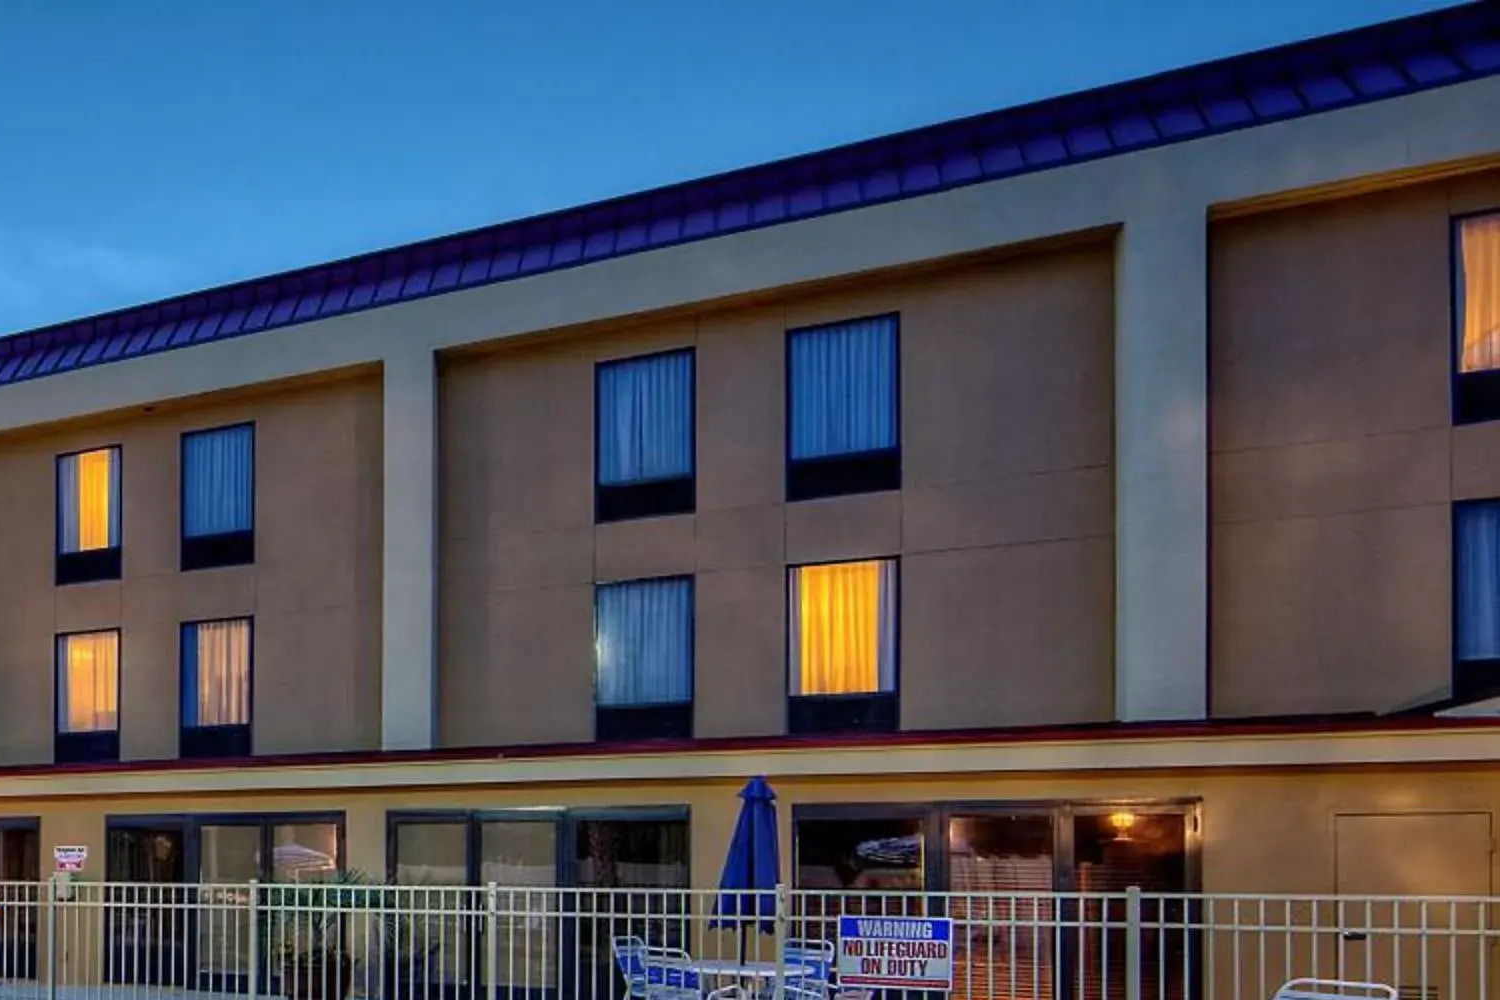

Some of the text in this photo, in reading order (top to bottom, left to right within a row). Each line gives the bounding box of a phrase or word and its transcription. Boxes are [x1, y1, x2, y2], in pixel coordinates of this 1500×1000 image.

[857, 920, 933, 938] WARNING
[843, 939, 947, 959] NO LIFEGUARD
[861, 957, 928, 977] ON DUTY
